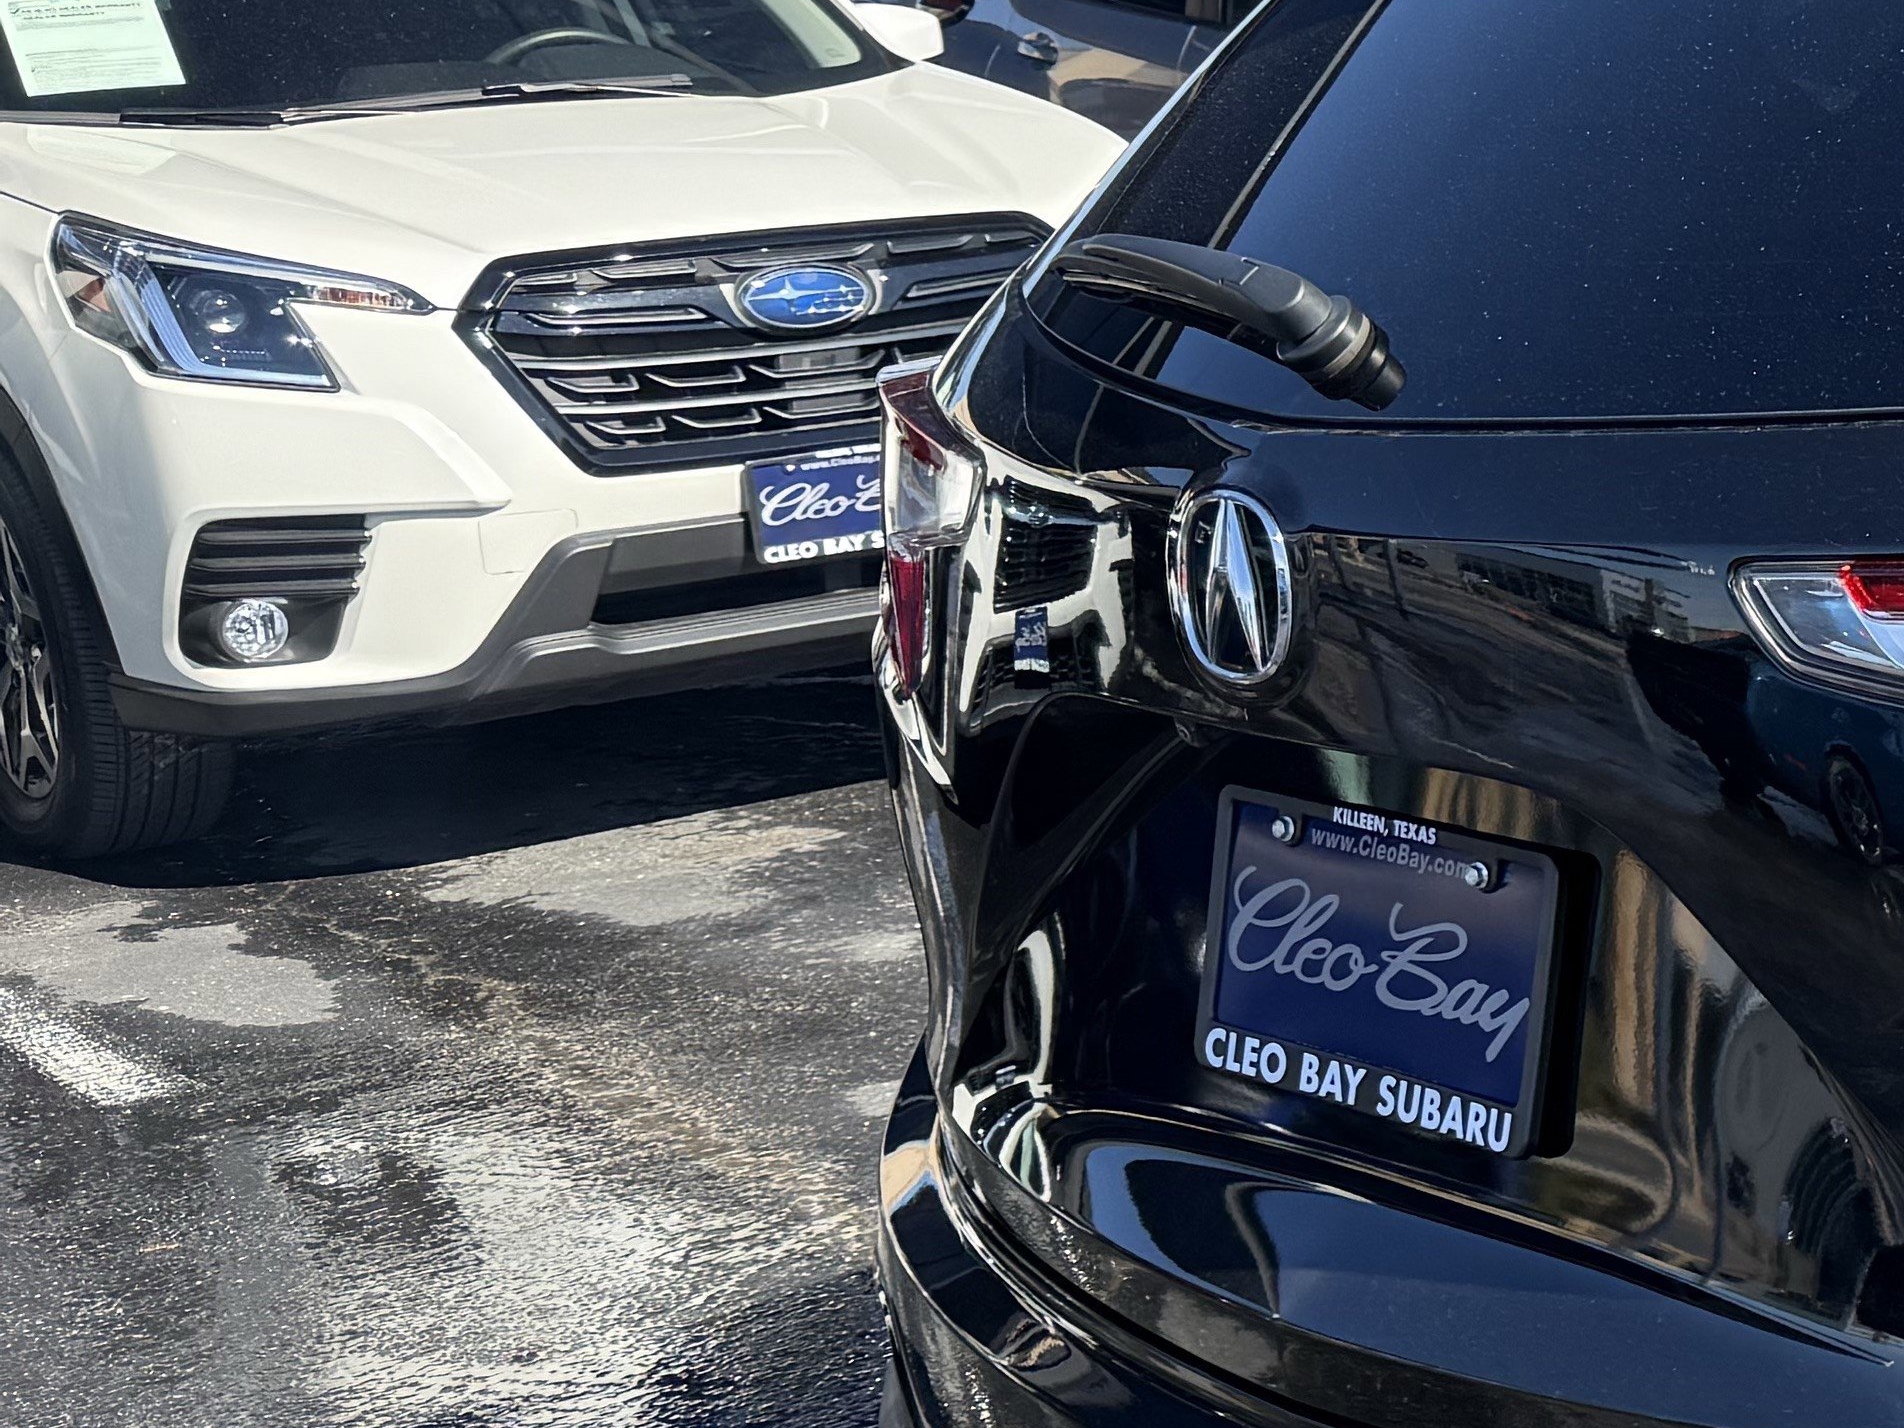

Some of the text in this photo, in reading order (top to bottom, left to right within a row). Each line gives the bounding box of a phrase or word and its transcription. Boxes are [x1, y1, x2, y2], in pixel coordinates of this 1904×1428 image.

[759, 482, 856, 526] Cleo
[764, 541, 818, 564] CLEO
[823, 534, 864, 555] BAY
[1333, 806, 1437, 845] KILLEEN, TEXAS
[1228, 866, 1531, 1063] Cleo Bay
[1205, 1028, 1512, 1153] CLEO BAY SUBARU
